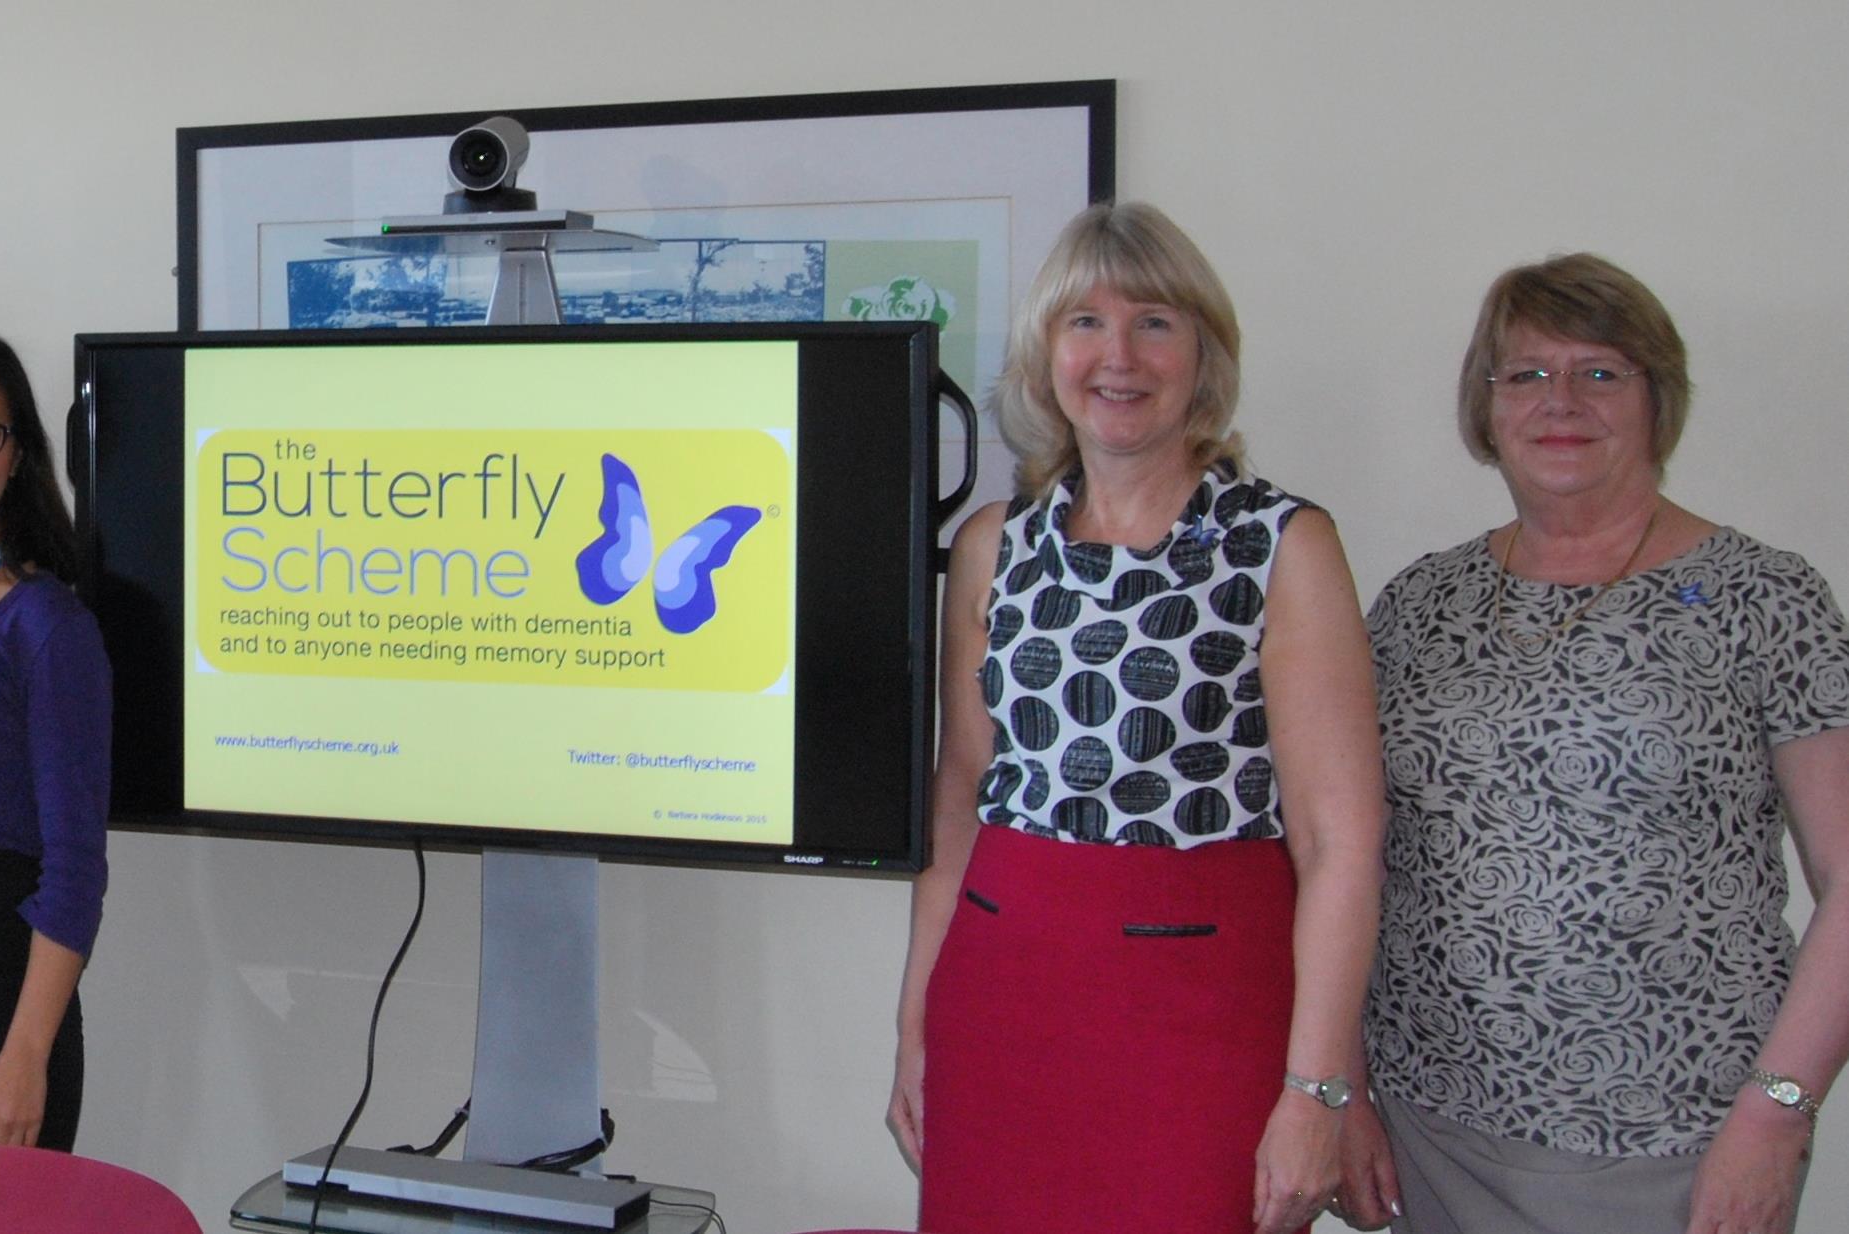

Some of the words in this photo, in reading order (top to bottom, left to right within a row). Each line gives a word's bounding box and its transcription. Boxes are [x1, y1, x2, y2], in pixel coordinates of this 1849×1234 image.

[275, 439, 316, 460] the
[222, 453, 566, 539] Butterfly
[221, 526, 530, 599] Scheme
[219, 606, 310, 632] reaching
[317, 610, 351, 628] out
[359, 610, 380, 629] to
[388, 611, 463, 635] people
[471, 613, 517, 633] with
[525, 614, 632, 637] dementia
[219, 635, 259, 654] and
[266, 636, 287, 655] to
[294, 639, 372, 661] anyone
[379, 639, 467, 666] needing
[475, 645, 567, 669] memory
[575, 648, 666, 671] support
[214, 735, 400, 756] www.butterflyscheme.org.uk
[567, 749, 621, 766] Twitter:
[625, 753, 756, 773] @butterflyscheme
[783, 854, 824, 865] SHARP
